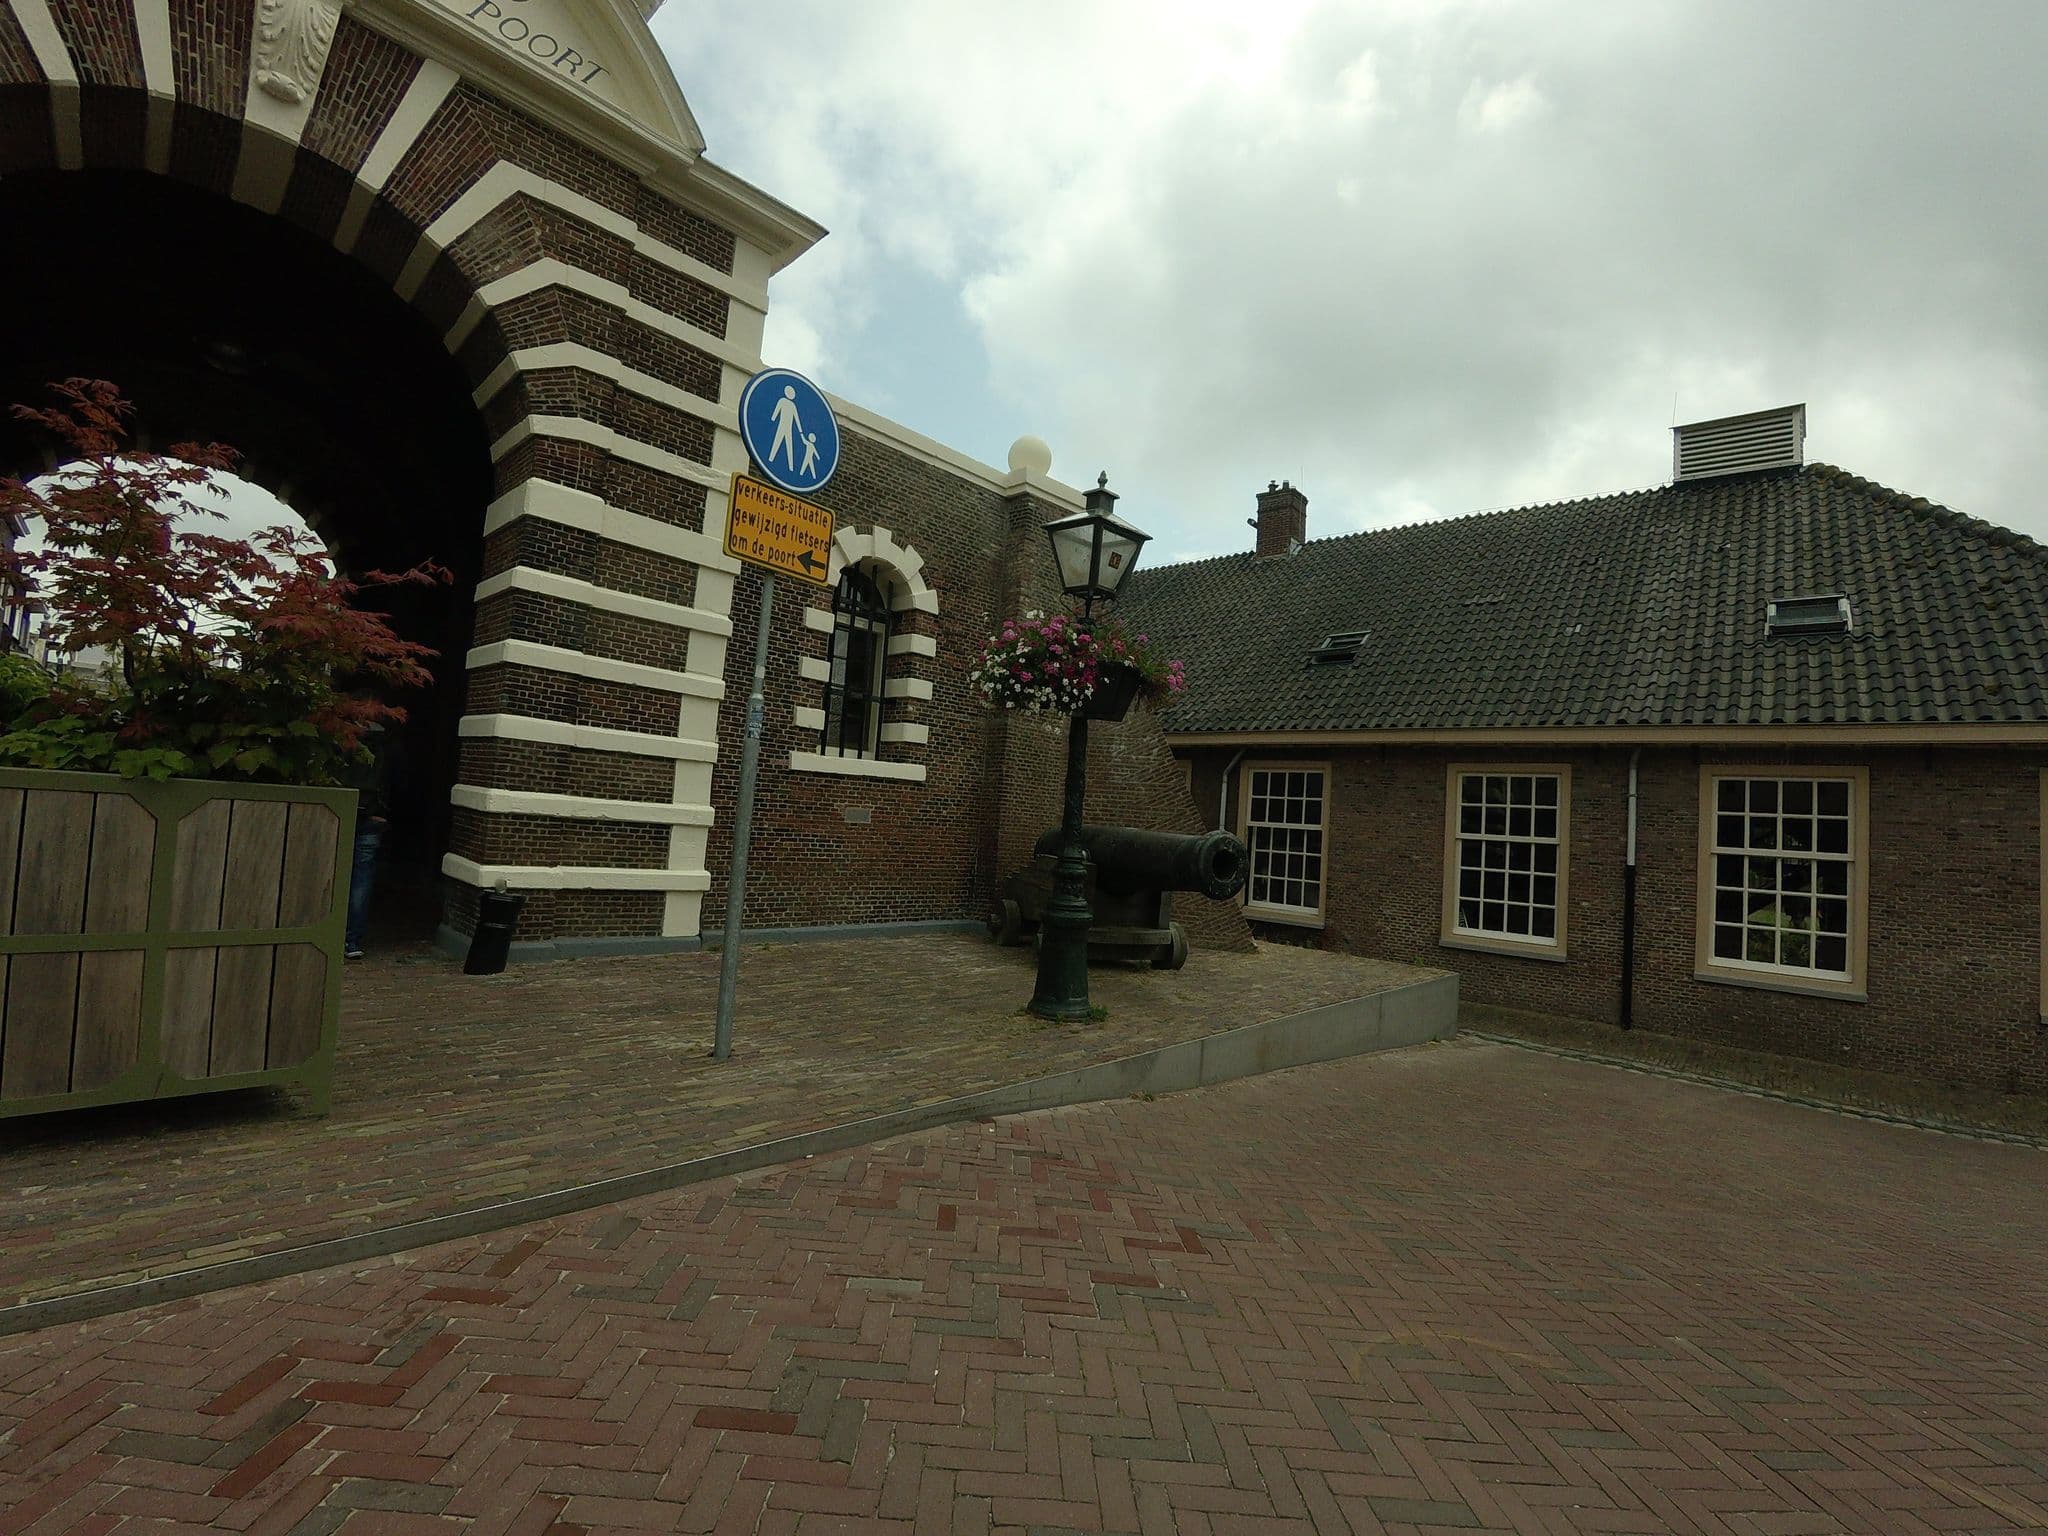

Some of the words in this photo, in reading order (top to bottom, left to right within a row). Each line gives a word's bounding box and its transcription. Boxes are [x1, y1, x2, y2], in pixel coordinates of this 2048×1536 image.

[466, 0, 610, 84] POORT
[737, 482, 828, 527] verkeers-situatie
[732, 534, 747, 550] om
[752, 538, 764, 555] de
[768, 546, 795, 566] poort
[735, 508, 787, 539] gewijzigd
[791, 525, 829, 552] fietsers
